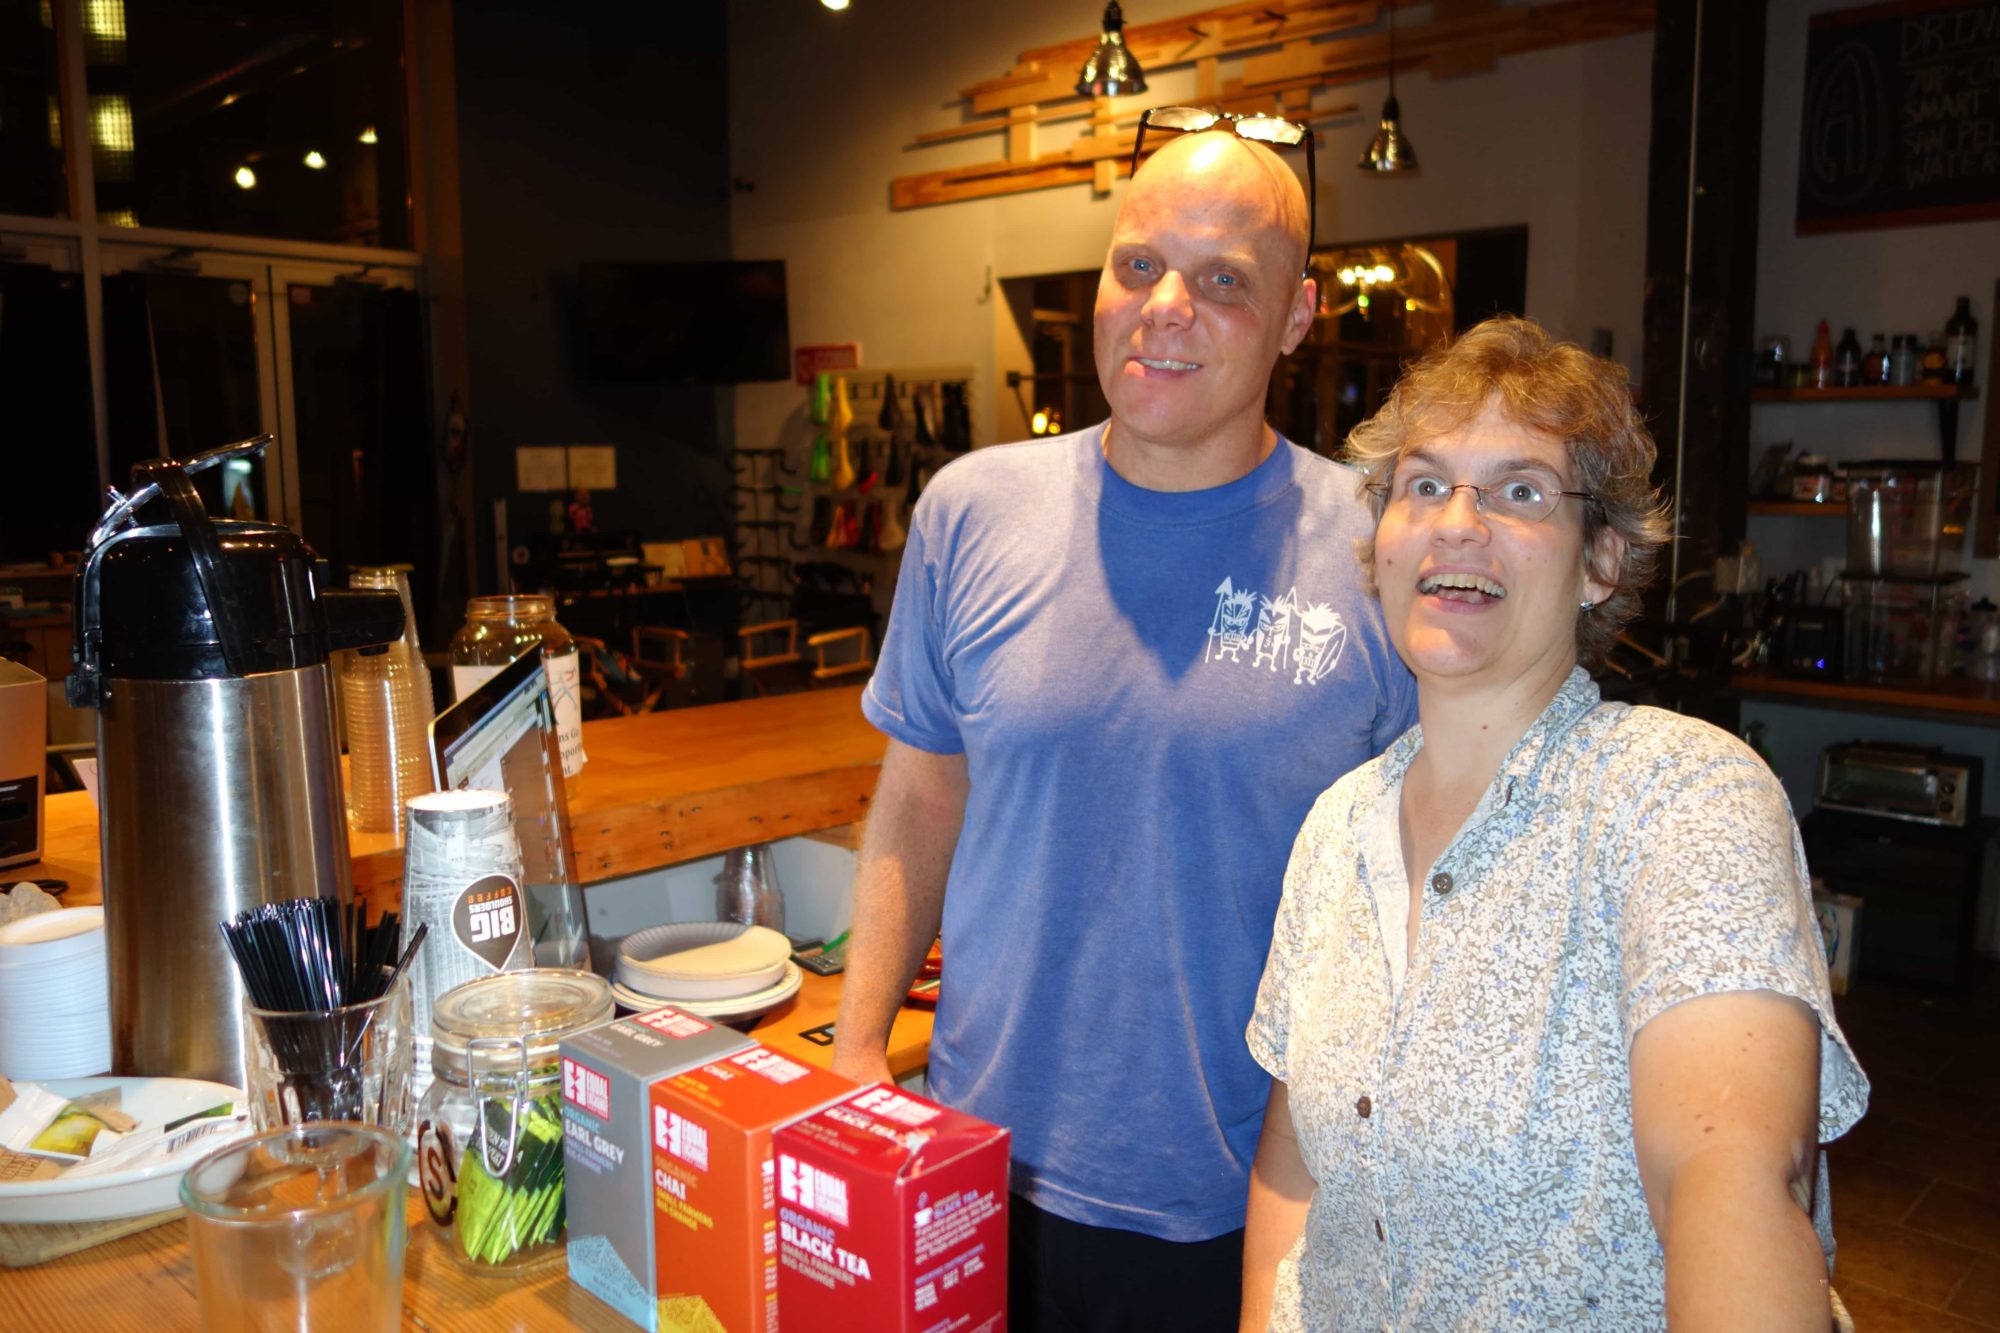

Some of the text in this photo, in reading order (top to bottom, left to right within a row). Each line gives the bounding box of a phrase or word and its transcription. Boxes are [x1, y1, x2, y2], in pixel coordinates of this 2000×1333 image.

[467, 886, 513, 904] COFFEE
[469, 895, 513, 914] SHOULDERS
[470, 905, 516, 943] BIG
[824, 1108, 868, 1129] BLACK
[565, 1118, 624, 1165] EARL GREY
[655, 1168, 686, 1201] CHAI
[780, 1206, 835, 1245] ORGANIC
[780, 1220, 835, 1264] BLACK
[835, 1247, 872, 1280] TEA
